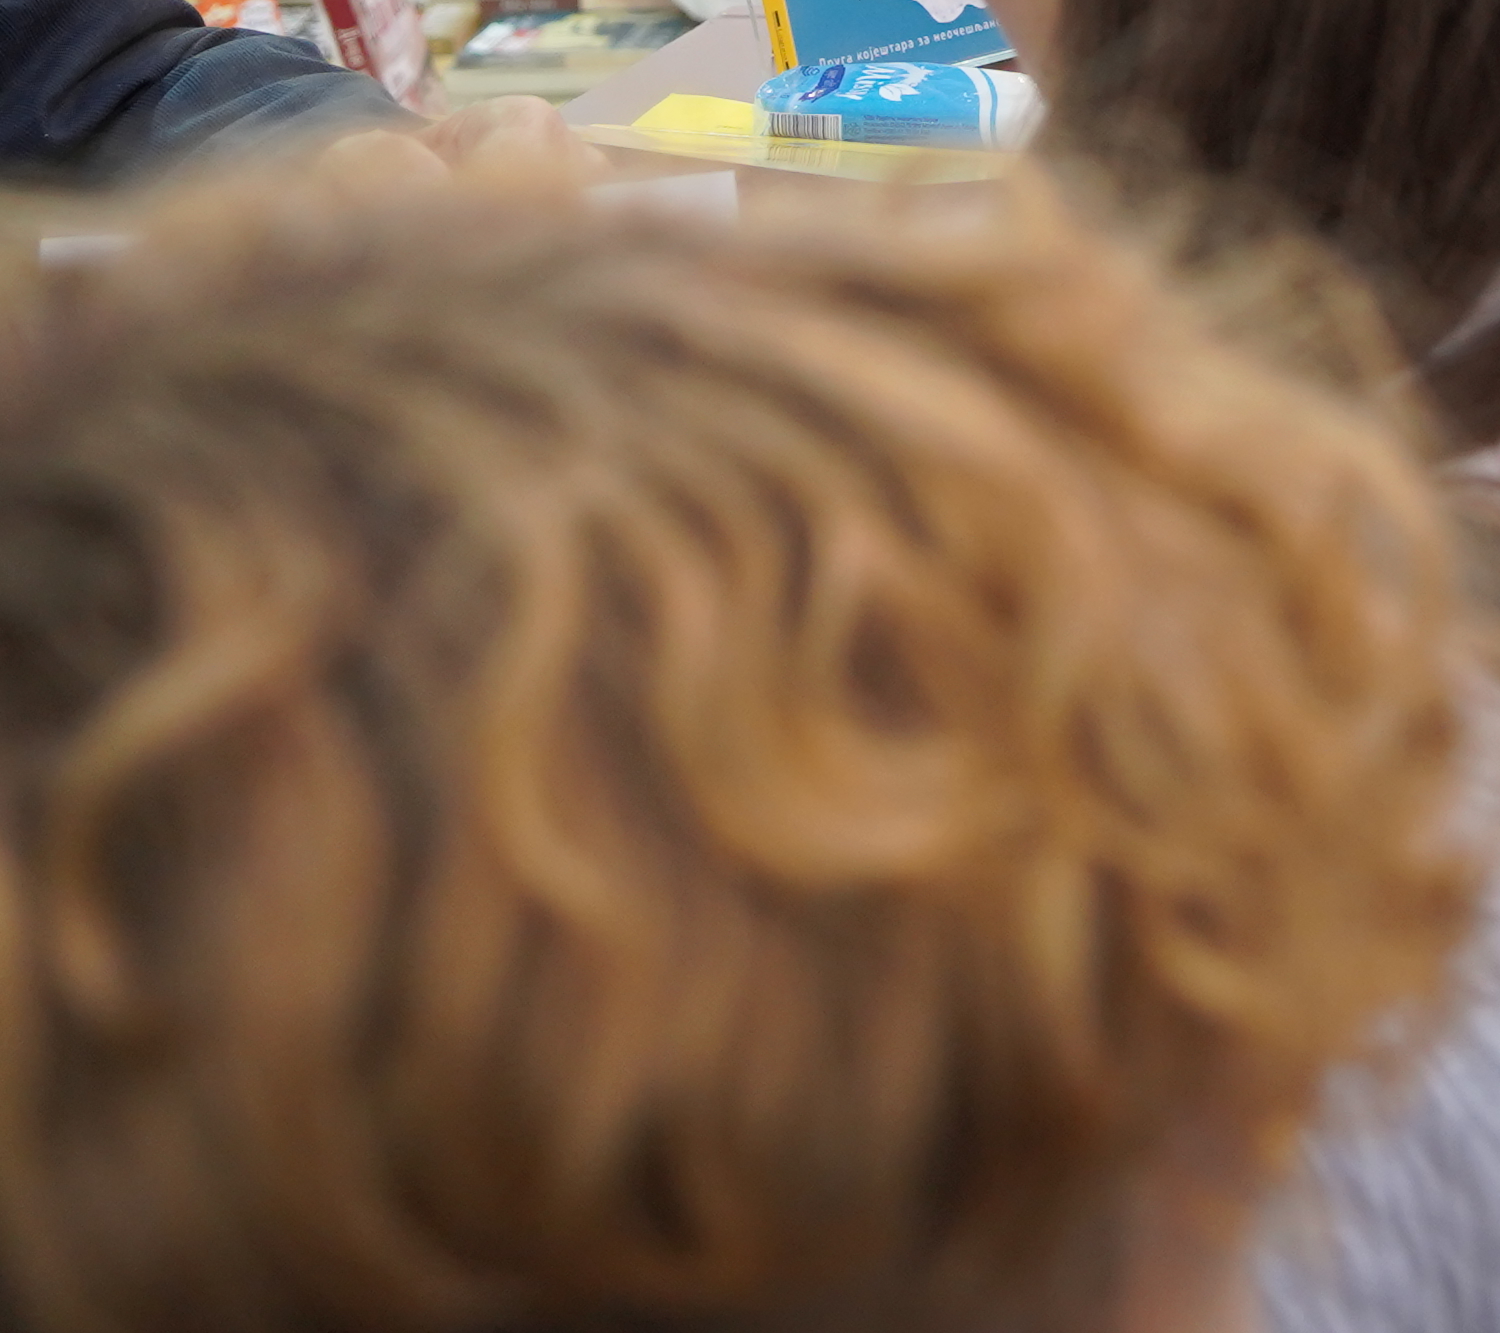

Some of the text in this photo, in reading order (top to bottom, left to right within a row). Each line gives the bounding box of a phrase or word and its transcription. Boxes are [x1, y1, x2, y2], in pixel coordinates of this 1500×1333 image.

[857, 38, 915, 62] којештара
[917, 34, 930, 46] за
[933, 17, 1002, 43] неочешљан
